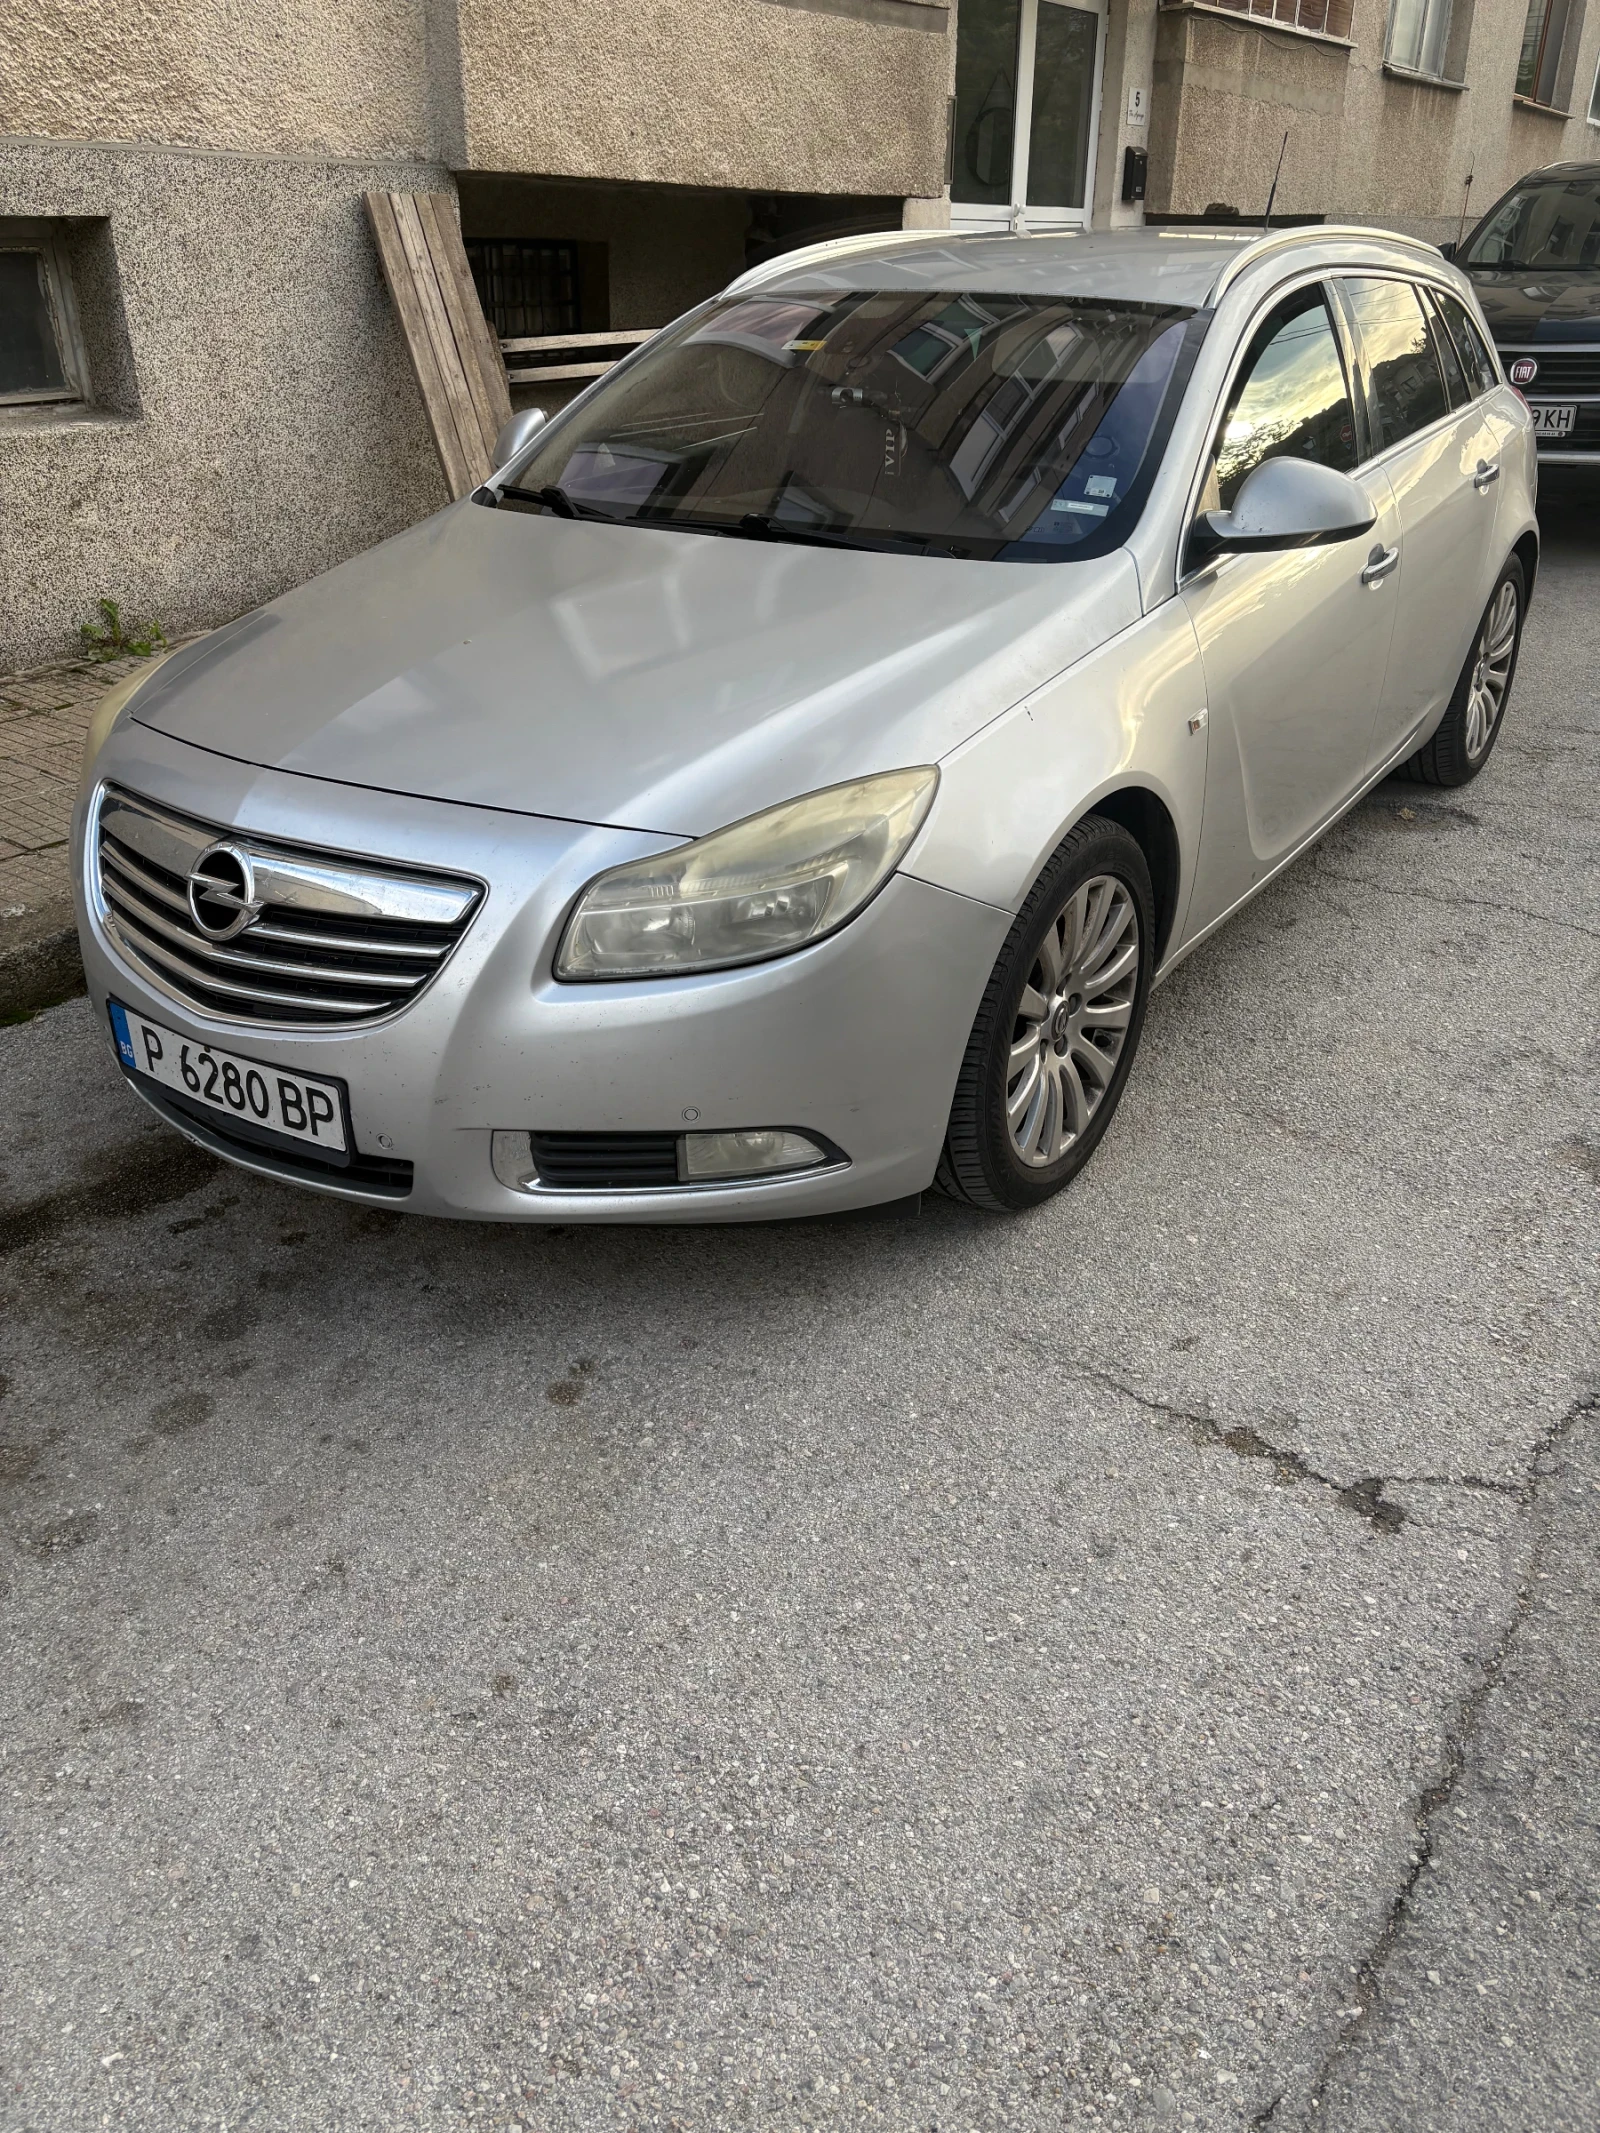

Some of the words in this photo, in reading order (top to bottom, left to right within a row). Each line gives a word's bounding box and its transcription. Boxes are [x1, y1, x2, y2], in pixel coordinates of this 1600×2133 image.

[1135, 91, 1141, 107] 5
[1514, 366, 1532, 379] FIAT
[1543, 409, 1571, 428] KH
[120, 1041, 134, 1058] BG
[141, 1025, 163, 1072] P
[181, 1044, 269, 1119] 6280
[277, 1078, 334, 1136] BP
